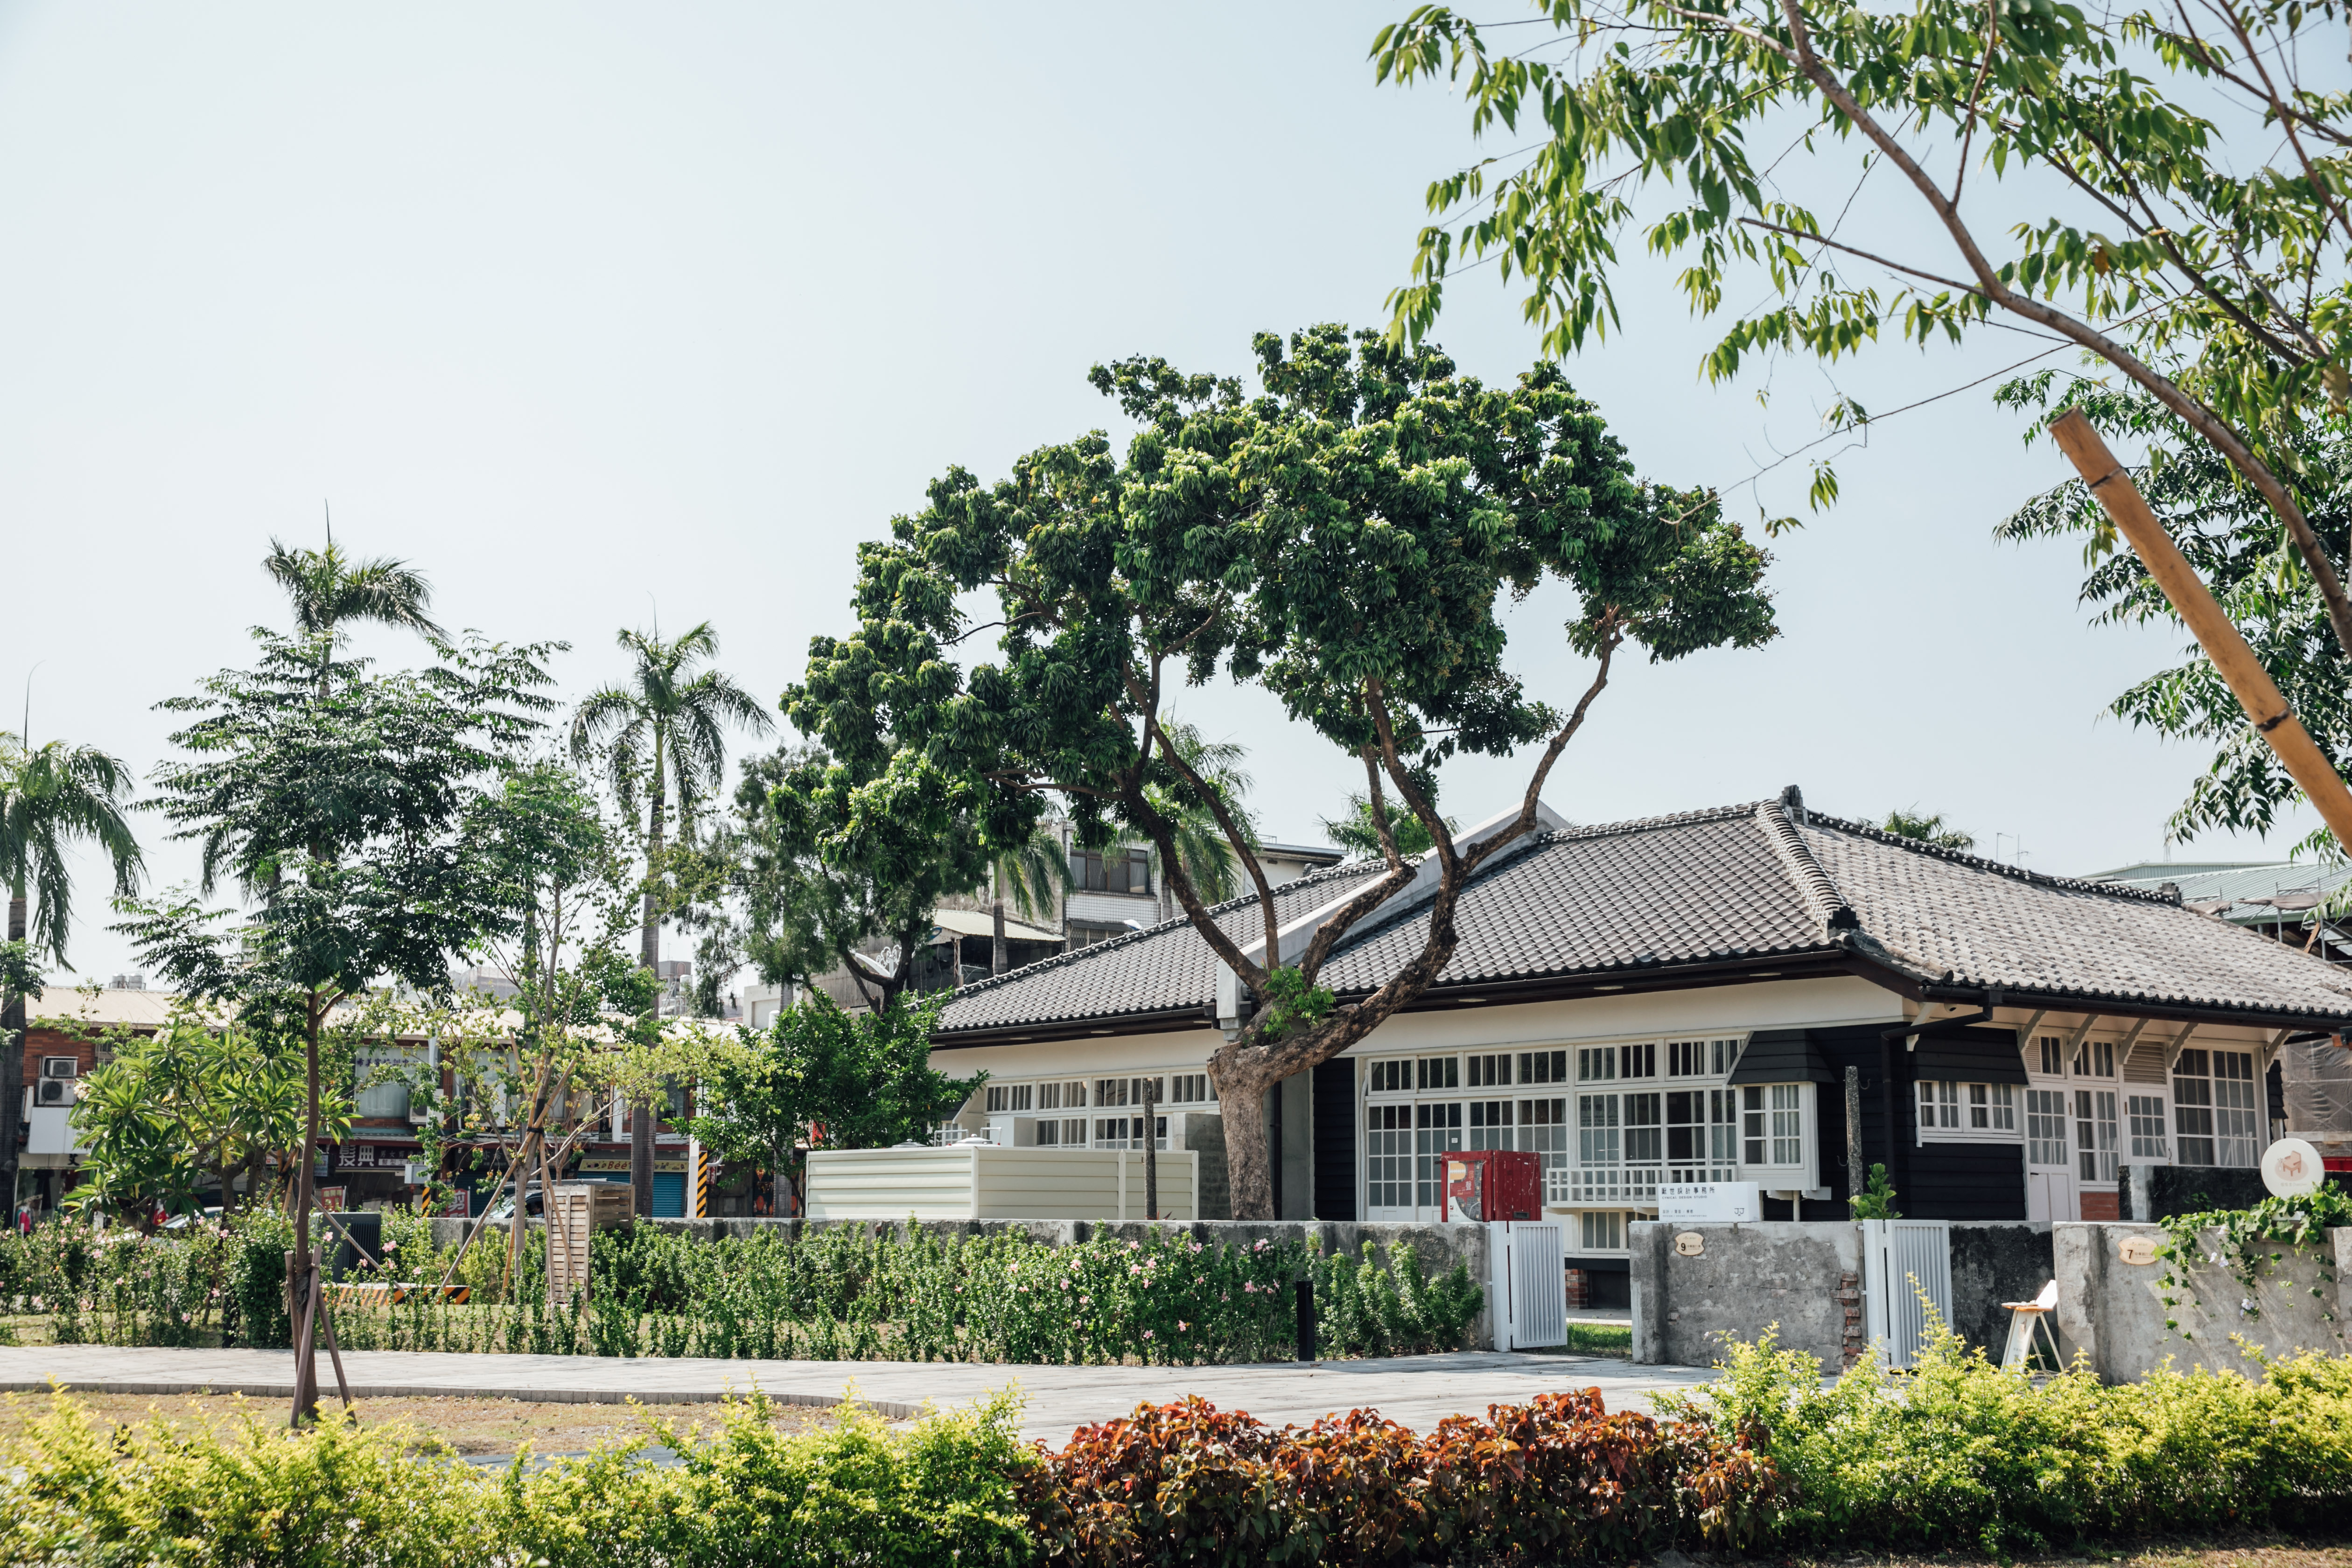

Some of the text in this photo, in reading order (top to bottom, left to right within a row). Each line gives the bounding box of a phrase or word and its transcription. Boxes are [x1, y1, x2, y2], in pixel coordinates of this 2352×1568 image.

[1661, 1186, 1715, 1195] 厭世設計事務所
[1681, 1243, 1686, 1251] 9
[2127, 1250, 2133, 1259] 7
